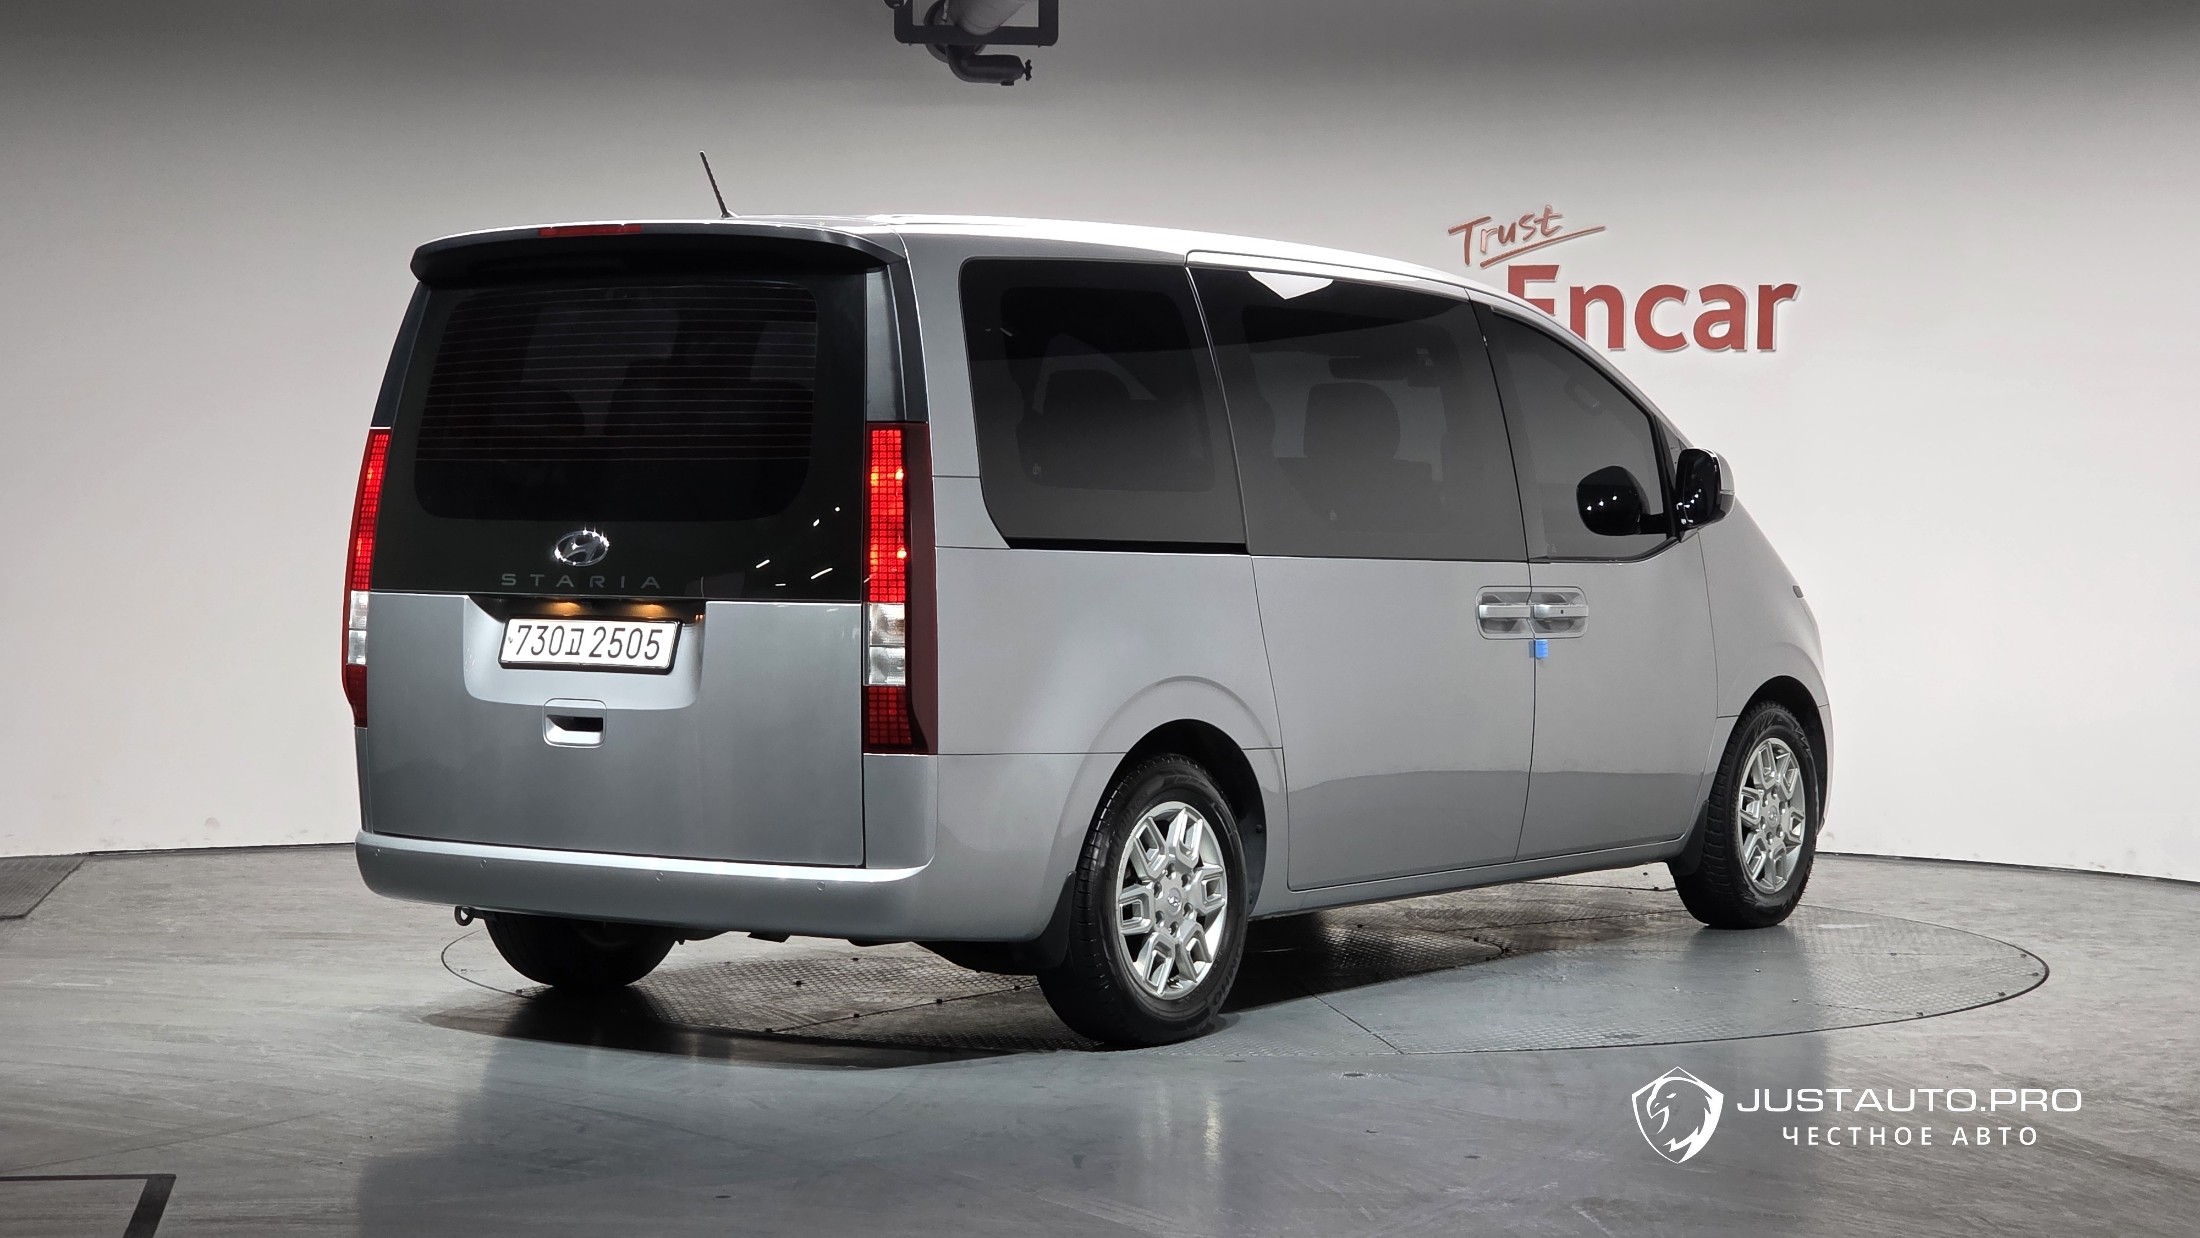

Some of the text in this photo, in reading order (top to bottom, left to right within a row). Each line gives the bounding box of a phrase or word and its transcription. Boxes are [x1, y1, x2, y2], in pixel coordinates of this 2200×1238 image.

[1447, 204, 1564, 267] Trust
[1507, 264, 1800, 352] Encar
[500, 573, 661, 590] STARIA
[588, 625, 663, 660] 2505
